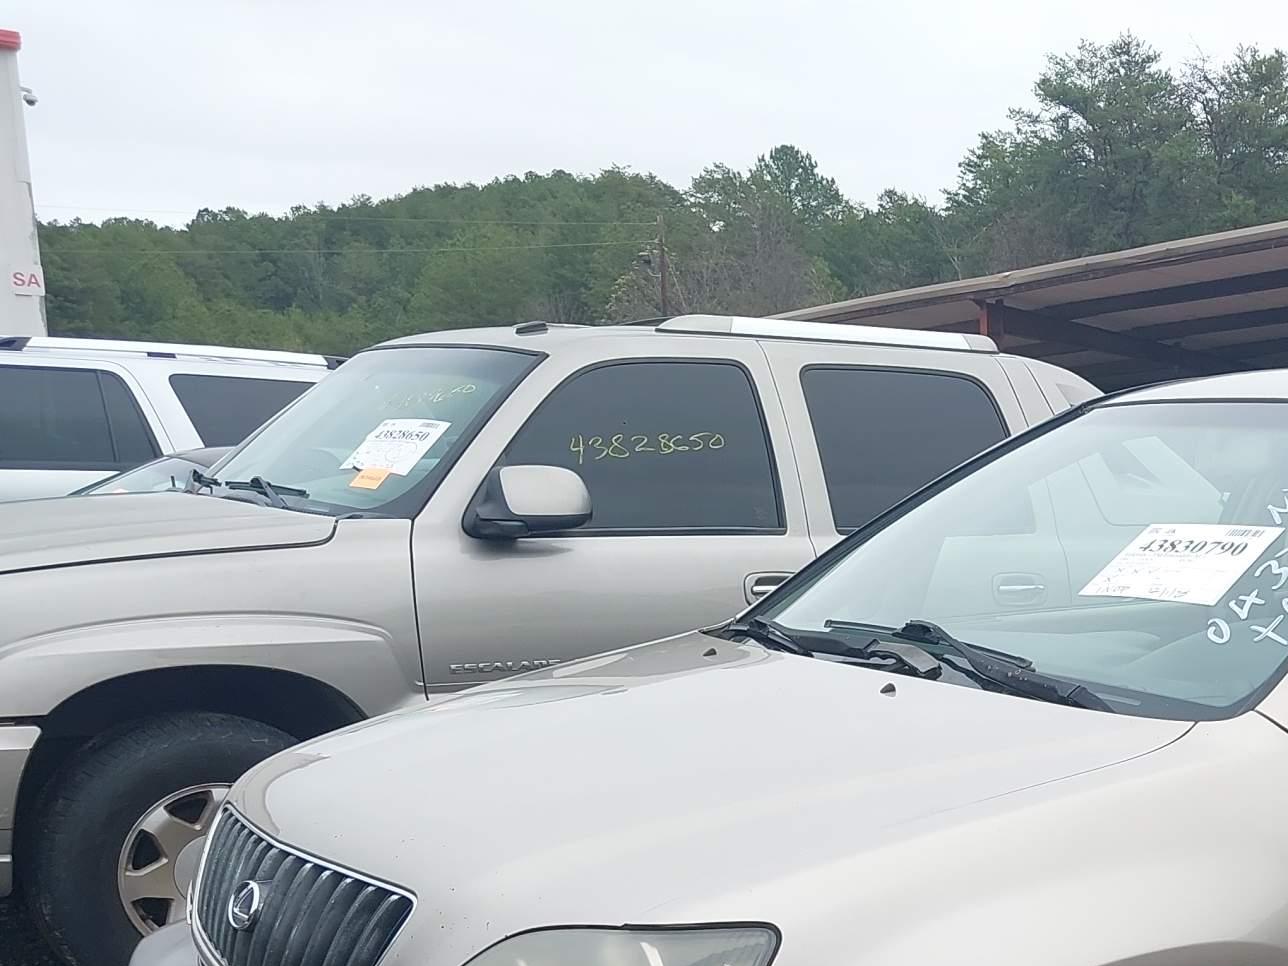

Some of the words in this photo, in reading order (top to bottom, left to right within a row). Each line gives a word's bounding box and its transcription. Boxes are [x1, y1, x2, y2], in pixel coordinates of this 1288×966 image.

[374, 429, 430, 441] 43828650
[569, 432, 725, 465] 43828650
[1139, 538, 1249, 557] 43830790
